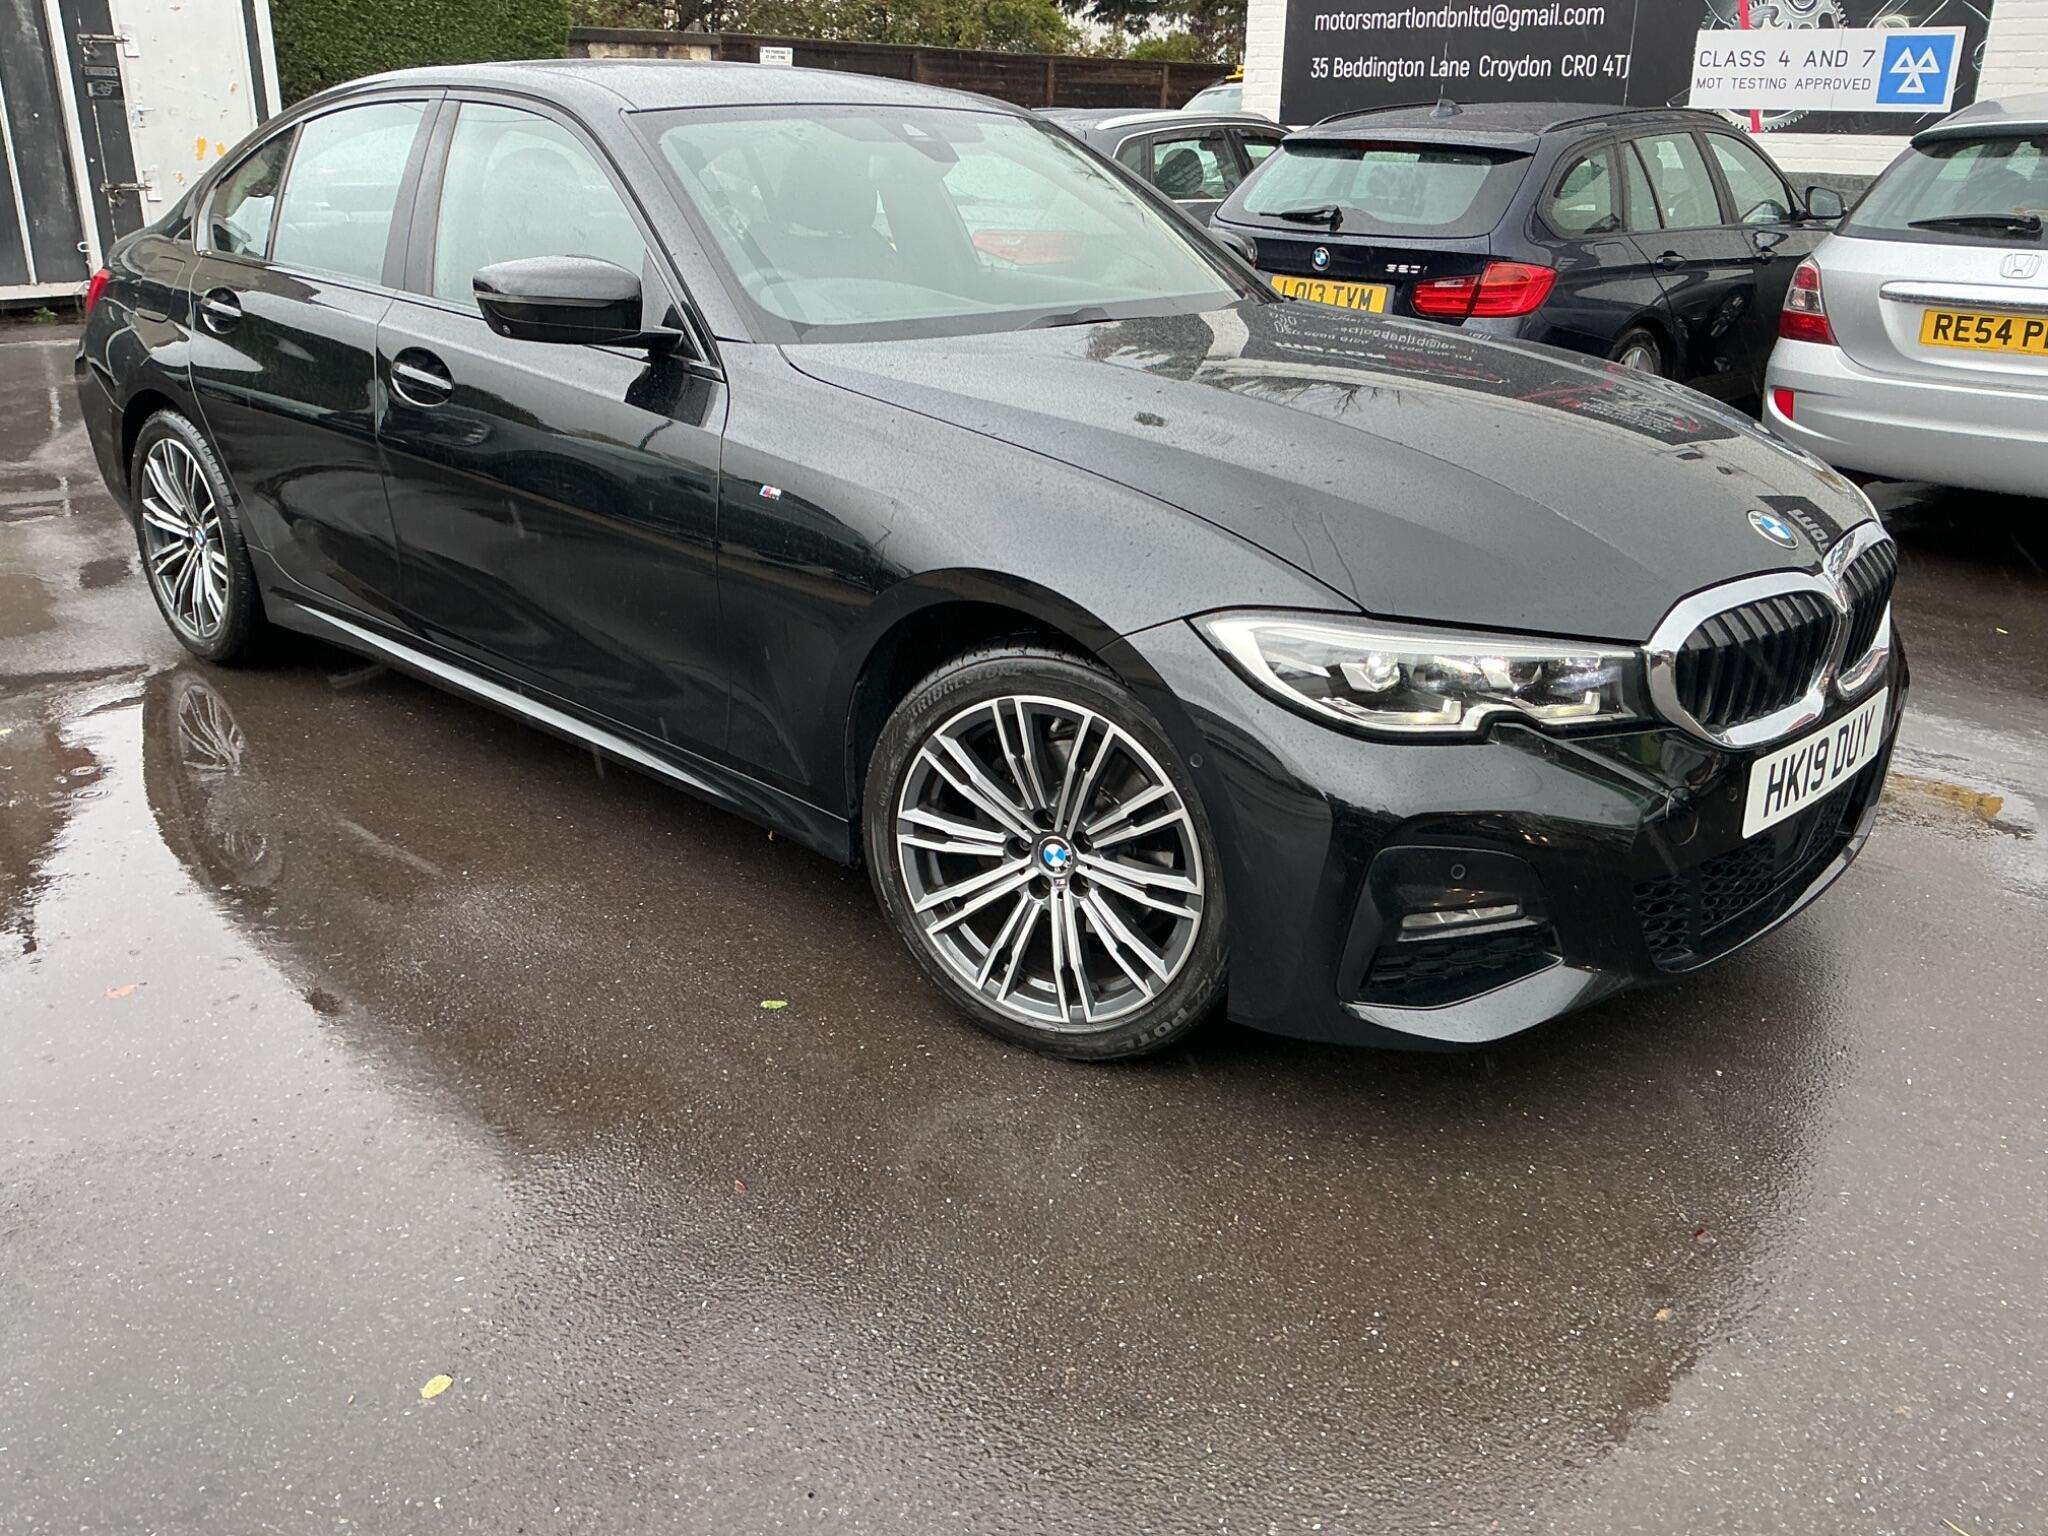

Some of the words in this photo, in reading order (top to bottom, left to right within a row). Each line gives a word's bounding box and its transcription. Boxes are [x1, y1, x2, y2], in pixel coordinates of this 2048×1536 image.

[1314, 3, 1605, 32] motorsmartlondonltd@gmail.com
[1310, 57, 1329, 78] 35
[1333, 56, 1424, 82] Beddington
[1429, 56, 1470, 78] Lane
[1478, 54, 1551, 82] Croydon
[1602, 54, 1632, 79] 4TJ
[1699, 49, 1766, 68] CLASS
[1778, 50, 1791, 67] 4
[1803, 49, 1849, 68] AND
[1862, 49, 1876, 68] 7
[1696, 76, 1723, 90] MOT
[1731, 77, 1787, 91] TESTING
[1794, 77, 1871, 91] APPROVED
[1933, 313, 2013, 346] RE54
[2022, 320, 2048, 349] P
[1763, 736, 1830, 819] HK19
[1831, 704, 1876, 780] DUY
